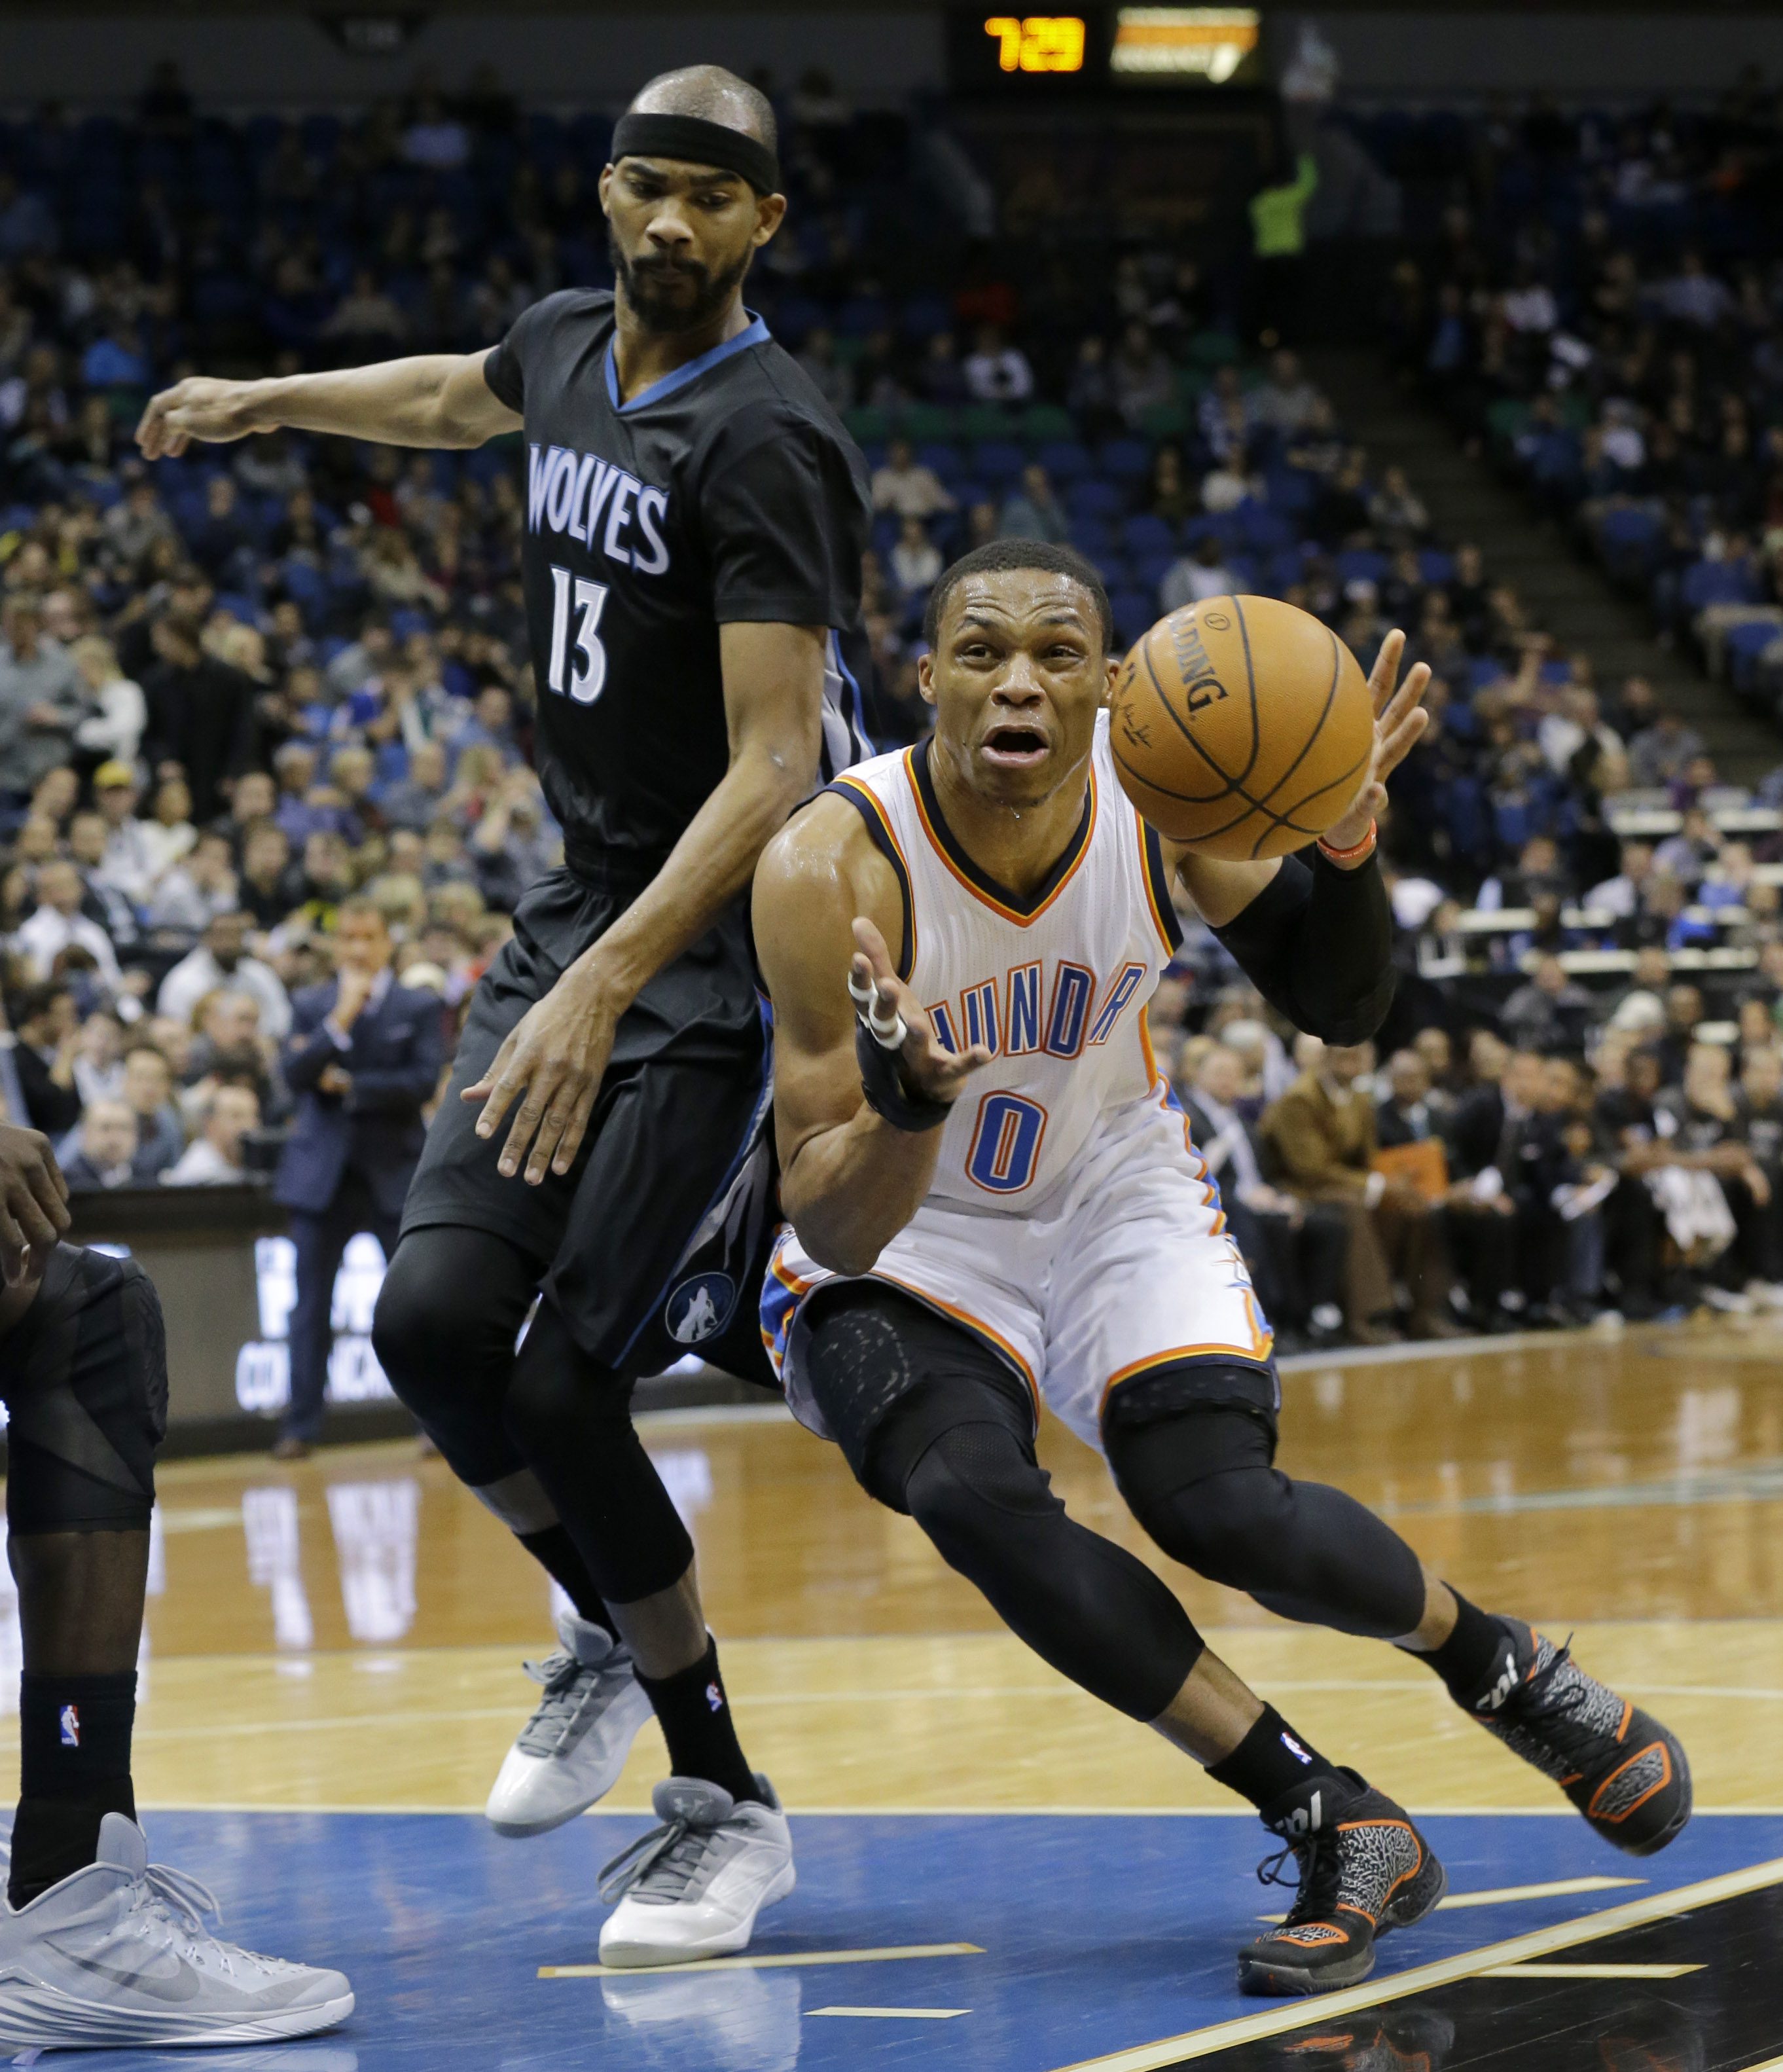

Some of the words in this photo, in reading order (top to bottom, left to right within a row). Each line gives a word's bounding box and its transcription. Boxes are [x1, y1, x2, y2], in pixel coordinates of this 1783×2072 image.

[528, 443, 670, 576] WOLVES
[548, 563, 610, 706] 13
[965, 1089, 1048, 1195] 0
